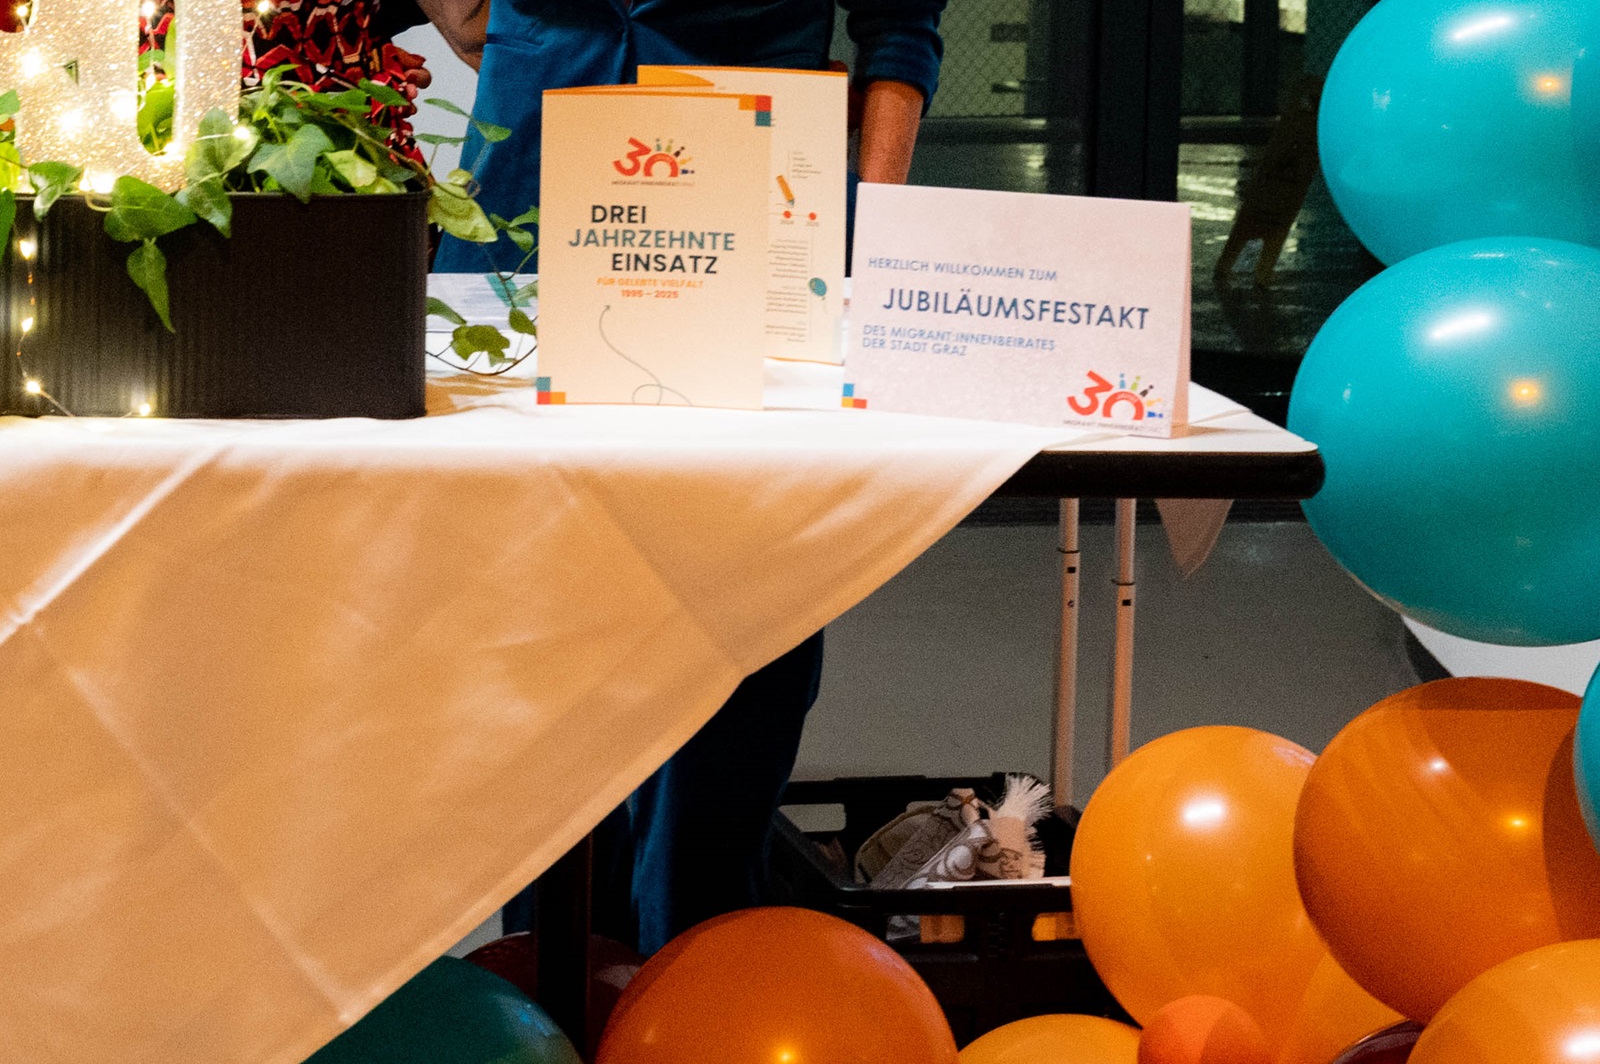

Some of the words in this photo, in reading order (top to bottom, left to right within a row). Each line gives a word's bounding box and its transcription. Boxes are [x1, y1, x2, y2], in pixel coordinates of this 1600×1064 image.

[591, 205, 647, 224] DREI
[568, 228, 735, 252] JAHRZEHNTE
[611, 253, 718, 275] EINSATZ
[868, 257, 929, 272] HERZLICH
[933, 262, 1025, 279] WILLKOMMEN
[1028, 269, 1058, 282] ZUM
[882, 288, 1150, 330] JUBILÄUMSFESTAKT
[863, 324, 886, 336] DES
[862, 337, 886, 349] DER
[890, 339, 928, 352] STADT
[931, 343, 968, 357] GRAZ
